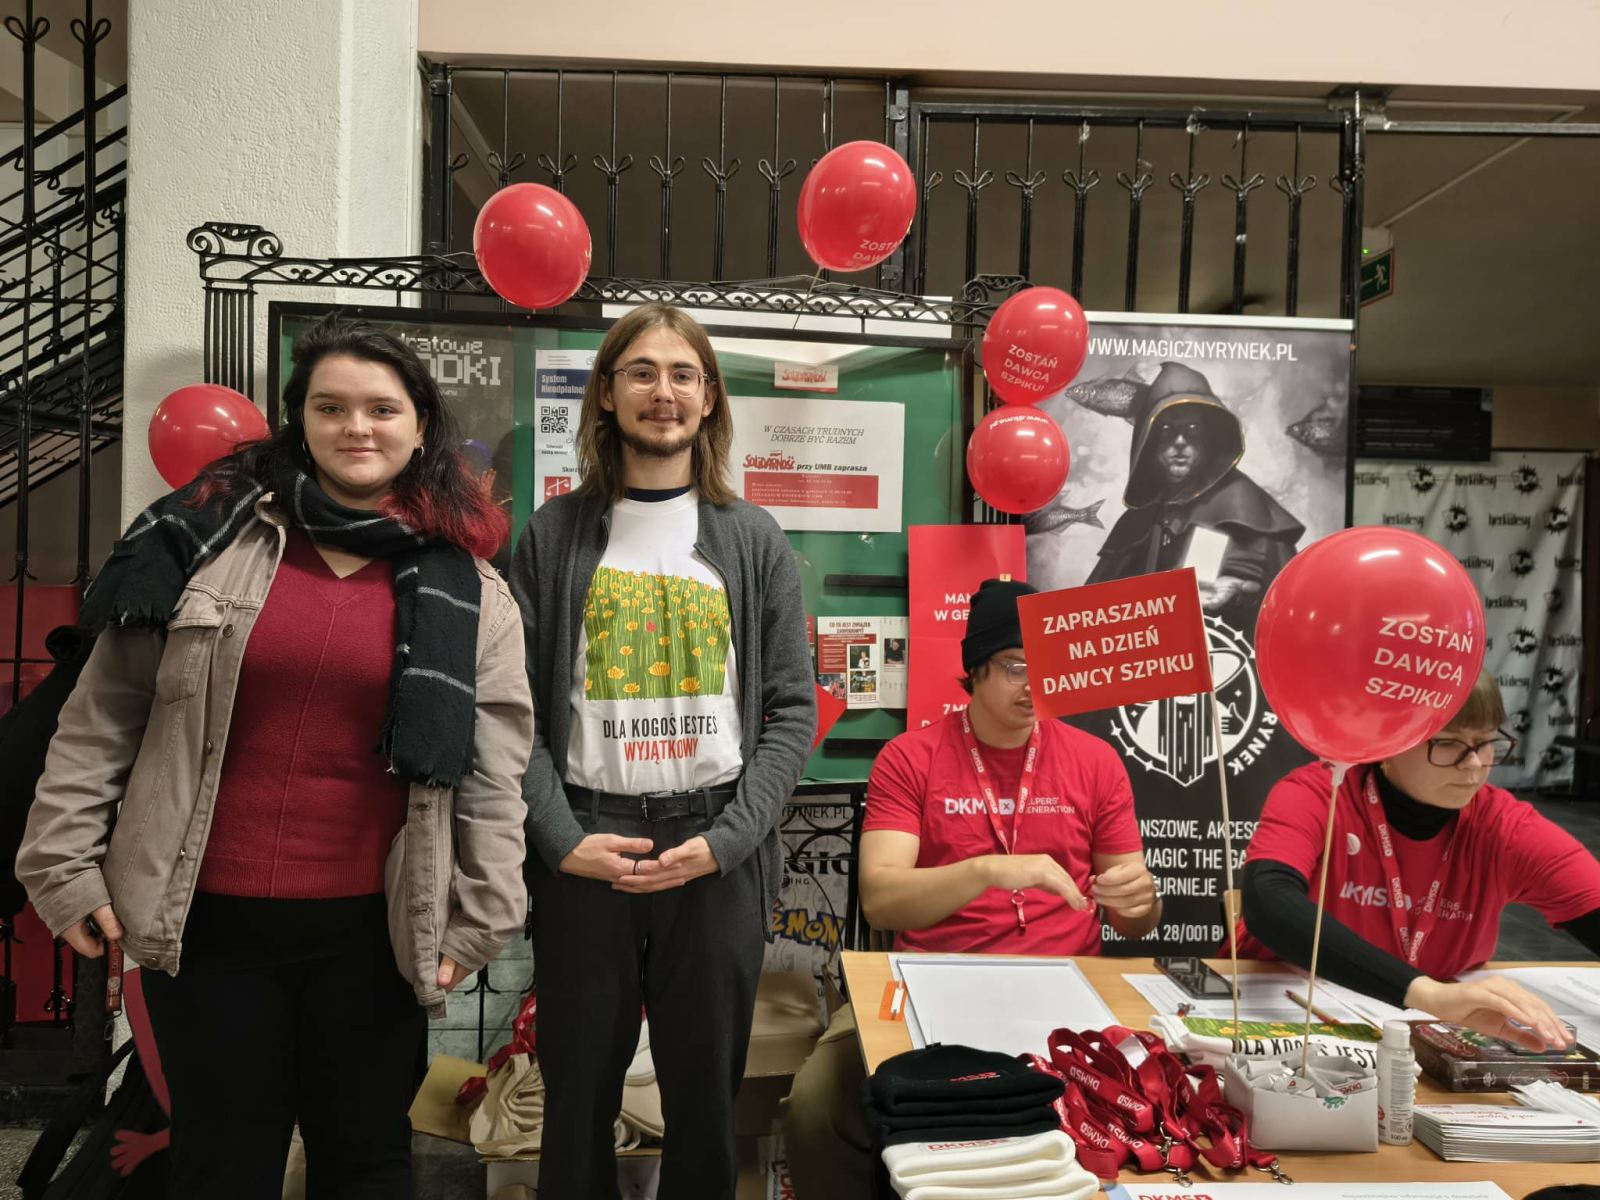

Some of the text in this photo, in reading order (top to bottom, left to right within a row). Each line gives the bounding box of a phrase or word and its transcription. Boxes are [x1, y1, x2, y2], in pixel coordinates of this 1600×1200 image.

[1008, 344, 1058, 369] ZOSTAŃ
[541, 375, 567, 384] System
[764, 425, 864, 436] W CZASACH TRUDNYCH
[770, 434, 857, 445] DOBRZE BYĆ RAZEM
[797, 463, 813, 471] przy
[934, 610, 970, 621] W GE
[1042, 595, 1176, 634] ZAPRASZAMY
[1068, 625, 1159, 660] NA DZIEŃ
[1379, 617, 1473, 654] ZOSTAŃ
[1043, 653, 1194, 695] DAWCY SZPIKU
[1374, 647, 1463, 687] DAWCĄ
[1365, 677, 1453, 709] SZPIKU!
[603, 711, 718, 739] DLA KOGOŚ JESTEŚ
[624, 738, 699, 765] WYJĄTKOWY
[1227, 711, 1278, 776] RYNEK
[945, 798, 987, 815] DKM
[1026, 805, 1075, 815] ENERATION
[1140, 819, 1202, 841] NSZOWE,
[1193, 849, 1223, 869] THE
[1157, 877, 1217, 896] URNIEJE
[1163, 923, 1208, 944] 28/001
